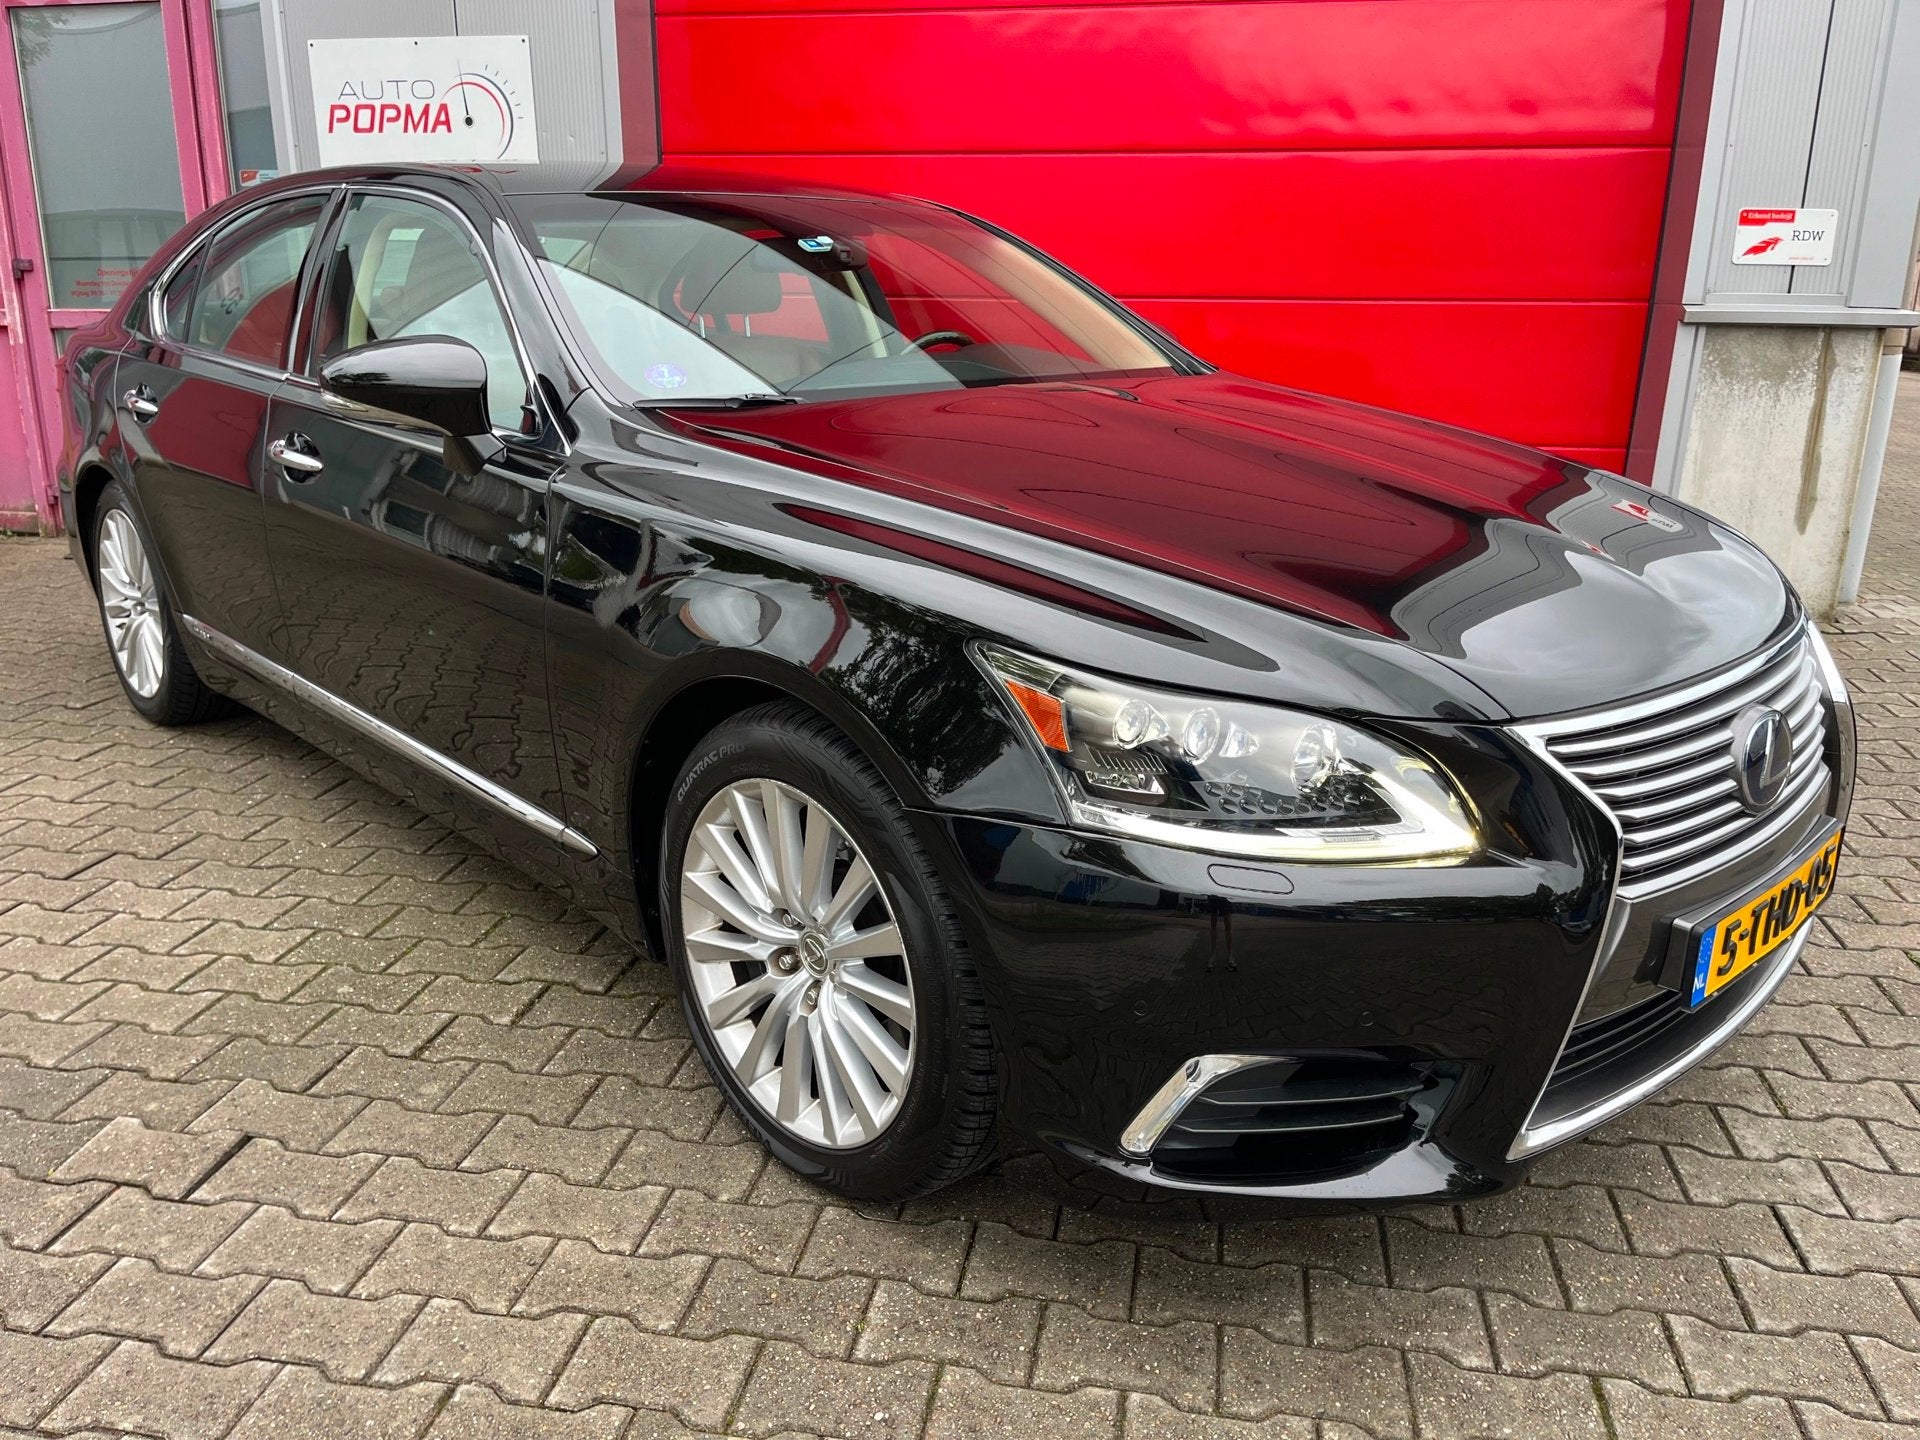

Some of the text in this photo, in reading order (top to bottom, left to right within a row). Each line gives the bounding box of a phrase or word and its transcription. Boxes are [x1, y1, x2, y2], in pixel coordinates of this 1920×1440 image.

[338, 79, 436, 101] AUTO
[328, 103, 453, 134] POPMA
[1791, 229, 1825, 242] RDW
[677, 750, 719, 801] QUATRAC
[1716, 844, 1836, 977] 5-THD-05
[1693, 973, 1705, 992] NL
